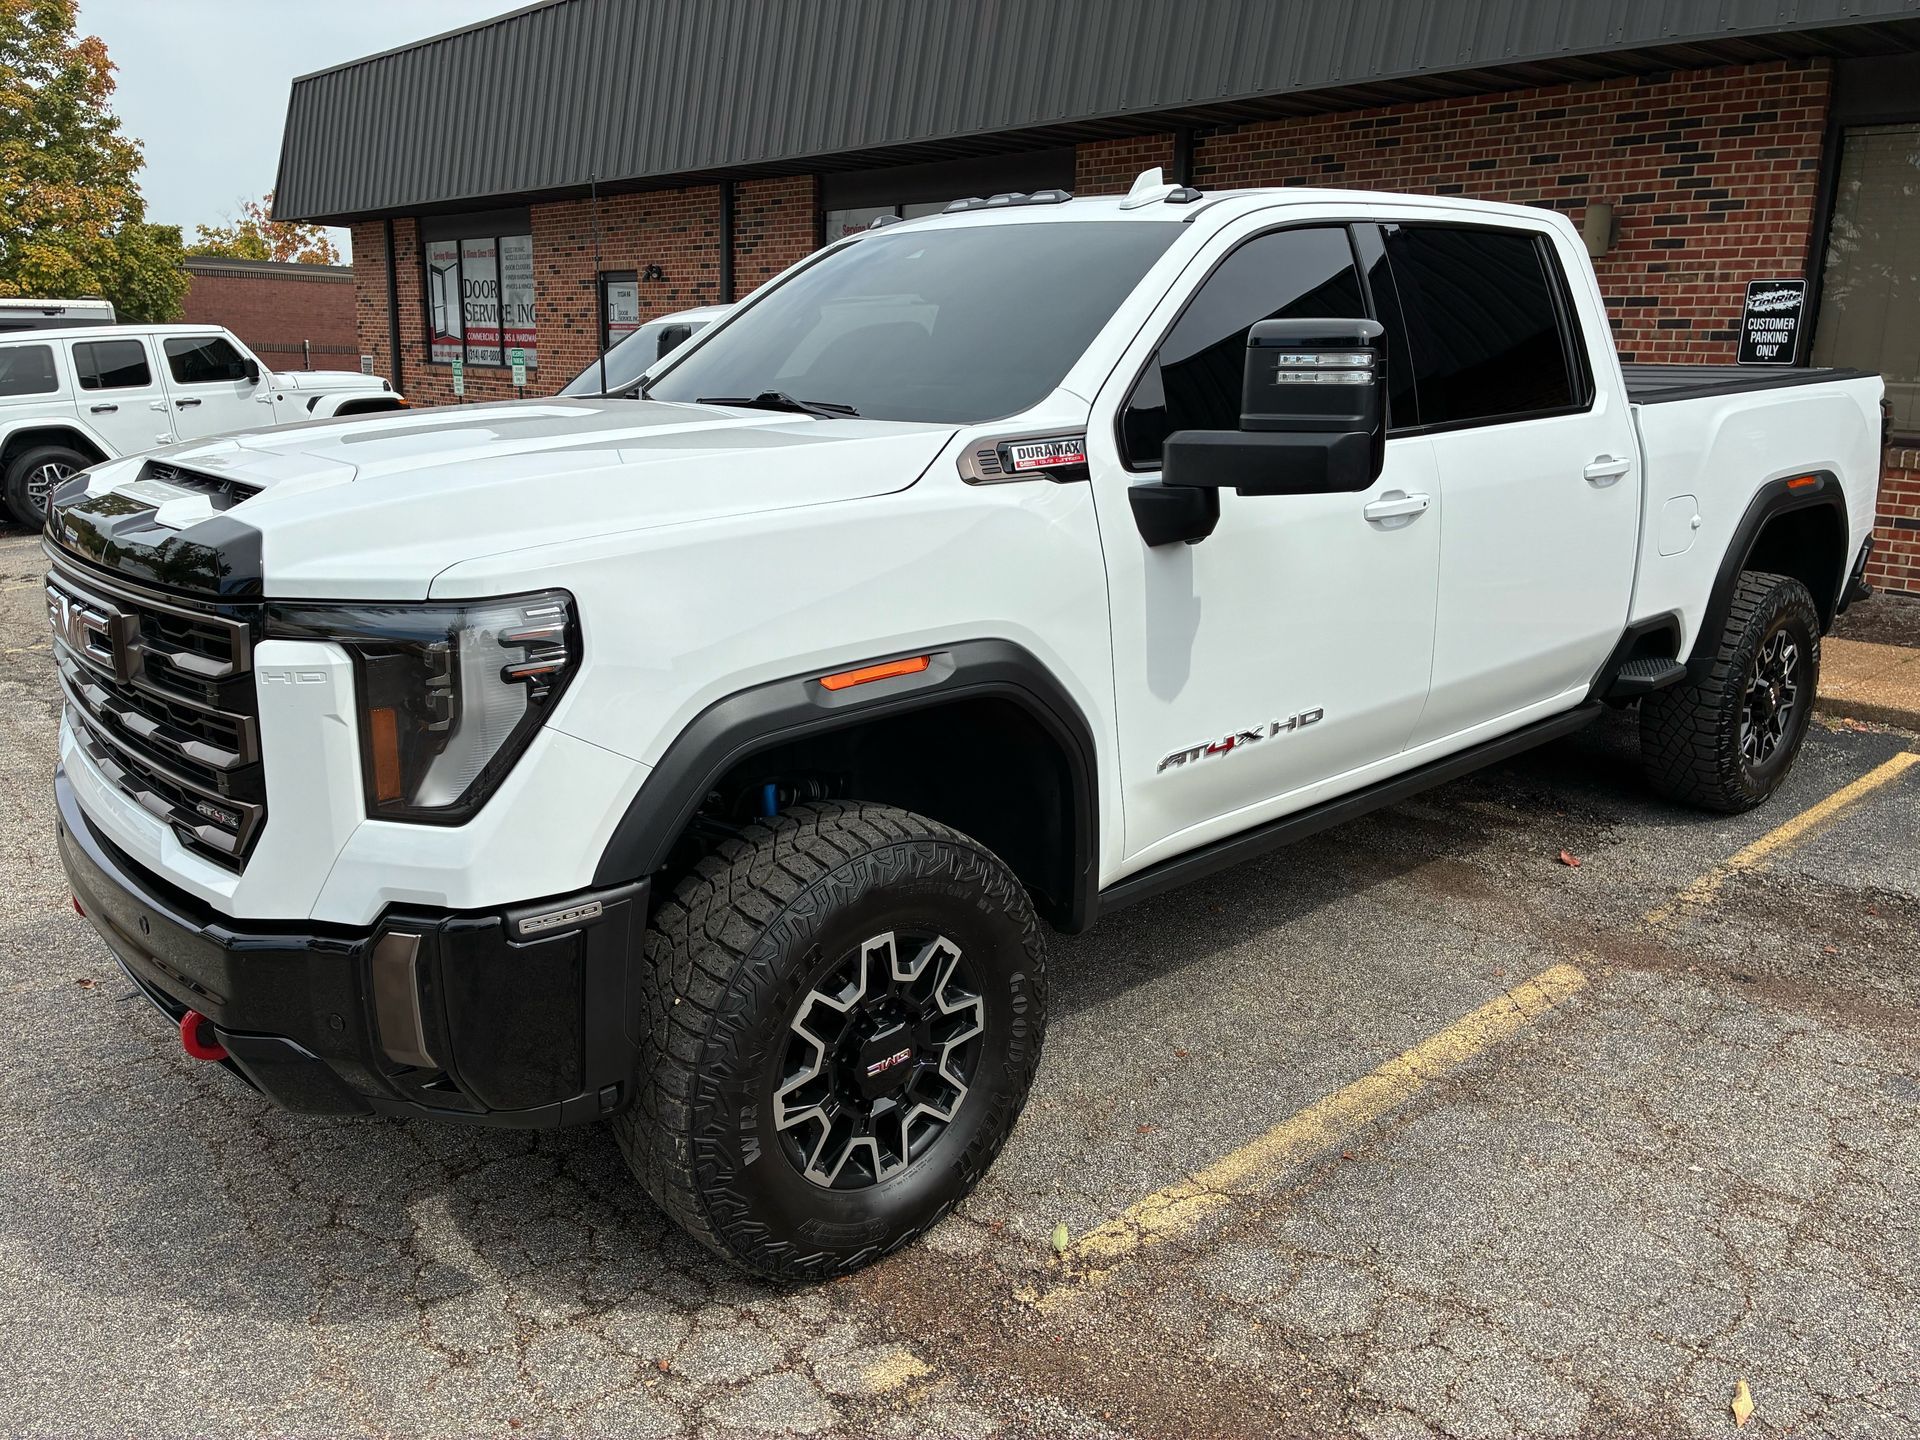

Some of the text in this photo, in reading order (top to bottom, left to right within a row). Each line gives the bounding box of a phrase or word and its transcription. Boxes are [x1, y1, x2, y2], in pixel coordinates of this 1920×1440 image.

[464, 279, 498, 299] DOOR
[1751, 292, 1801, 308] TintRite
[1747, 317, 1795, 330] CUSTOMER
[467, 332, 493, 341] COMMERCIAL
[1750, 331, 1788, 343] PARKING
[1756, 344, 1779, 357] ONLY
[1017, 441, 1081, 460] DURAMAX
[261, 671, 328, 684] HD
[1156, 706, 1324, 775] AT4X HD
[196, 803, 239, 827] AT4X
[522, 904, 600, 931] 2500
[737, 941, 824, 1168] WRANGLER
[866, 1047, 912, 1078] GMC
